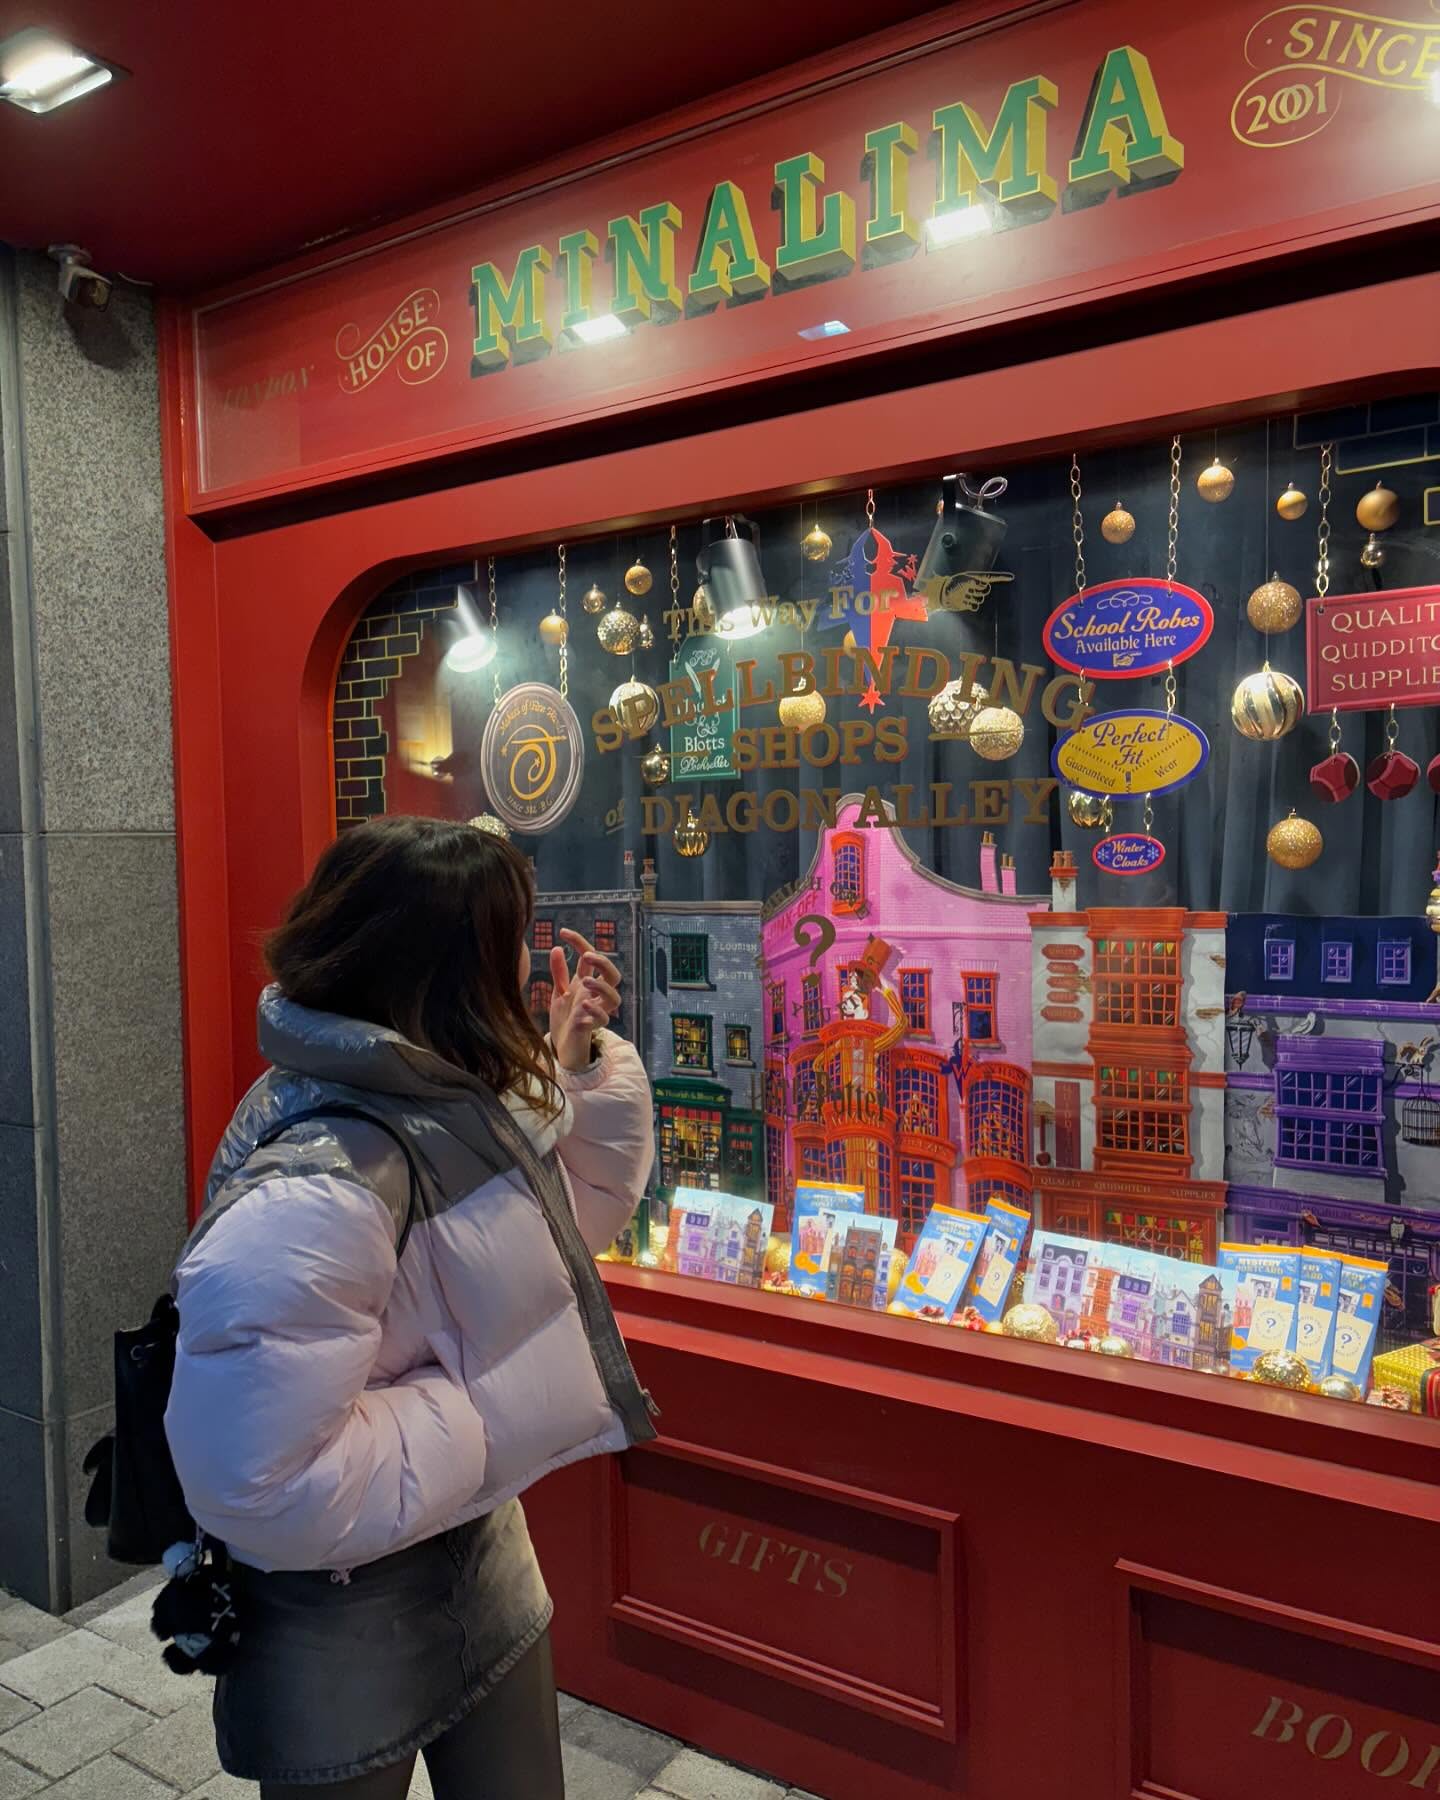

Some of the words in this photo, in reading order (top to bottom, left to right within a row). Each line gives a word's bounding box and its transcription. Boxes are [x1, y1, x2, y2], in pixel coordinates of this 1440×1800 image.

[1283, 17, 1440, 80] SINCE
[1246, 76, 1328, 134] 2001
[470, 44, 1185, 376] MINALIMA
[350, 296, 429, 387] HOUSE
[406, 340, 438, 371] OF
[663, 608, 735, 640] This
[746, 595, 821, 633] Way
[828, 585, 900, 620] For
[1055, 610, 1132, 640] School
[1131, 606, 1201, 632] Robes
[1331, 602, 1440, 634] QUALIT
[1075, 634, 1140, 654] Available
[1144, 632, 1177, 648] Here
[1330, 665, 1440, 693] SUPPLIE
[592, 645, 1098, 754] SPELLBINDING
[684, 736, 725, 752] Blotts
[731, 716, 910, 771] SHOPS
[1092, 722, 1168, 748] Perfect
[1065, 755, 1117, 789] Guaranteed
[1154, 758, 1178, 779] Wear
[1114, 744, 1143, 767] Fit
[604, 798, 629, 833] of
[639, 788, 838, 836] DIAGON
[853, 776, 1059, 829] ALLEY
[1110, 839, 1147, 854] Winter
[1111, 854, 1149, 868] Cloaks
[698, 1521, 855, 1599] GIFTS
